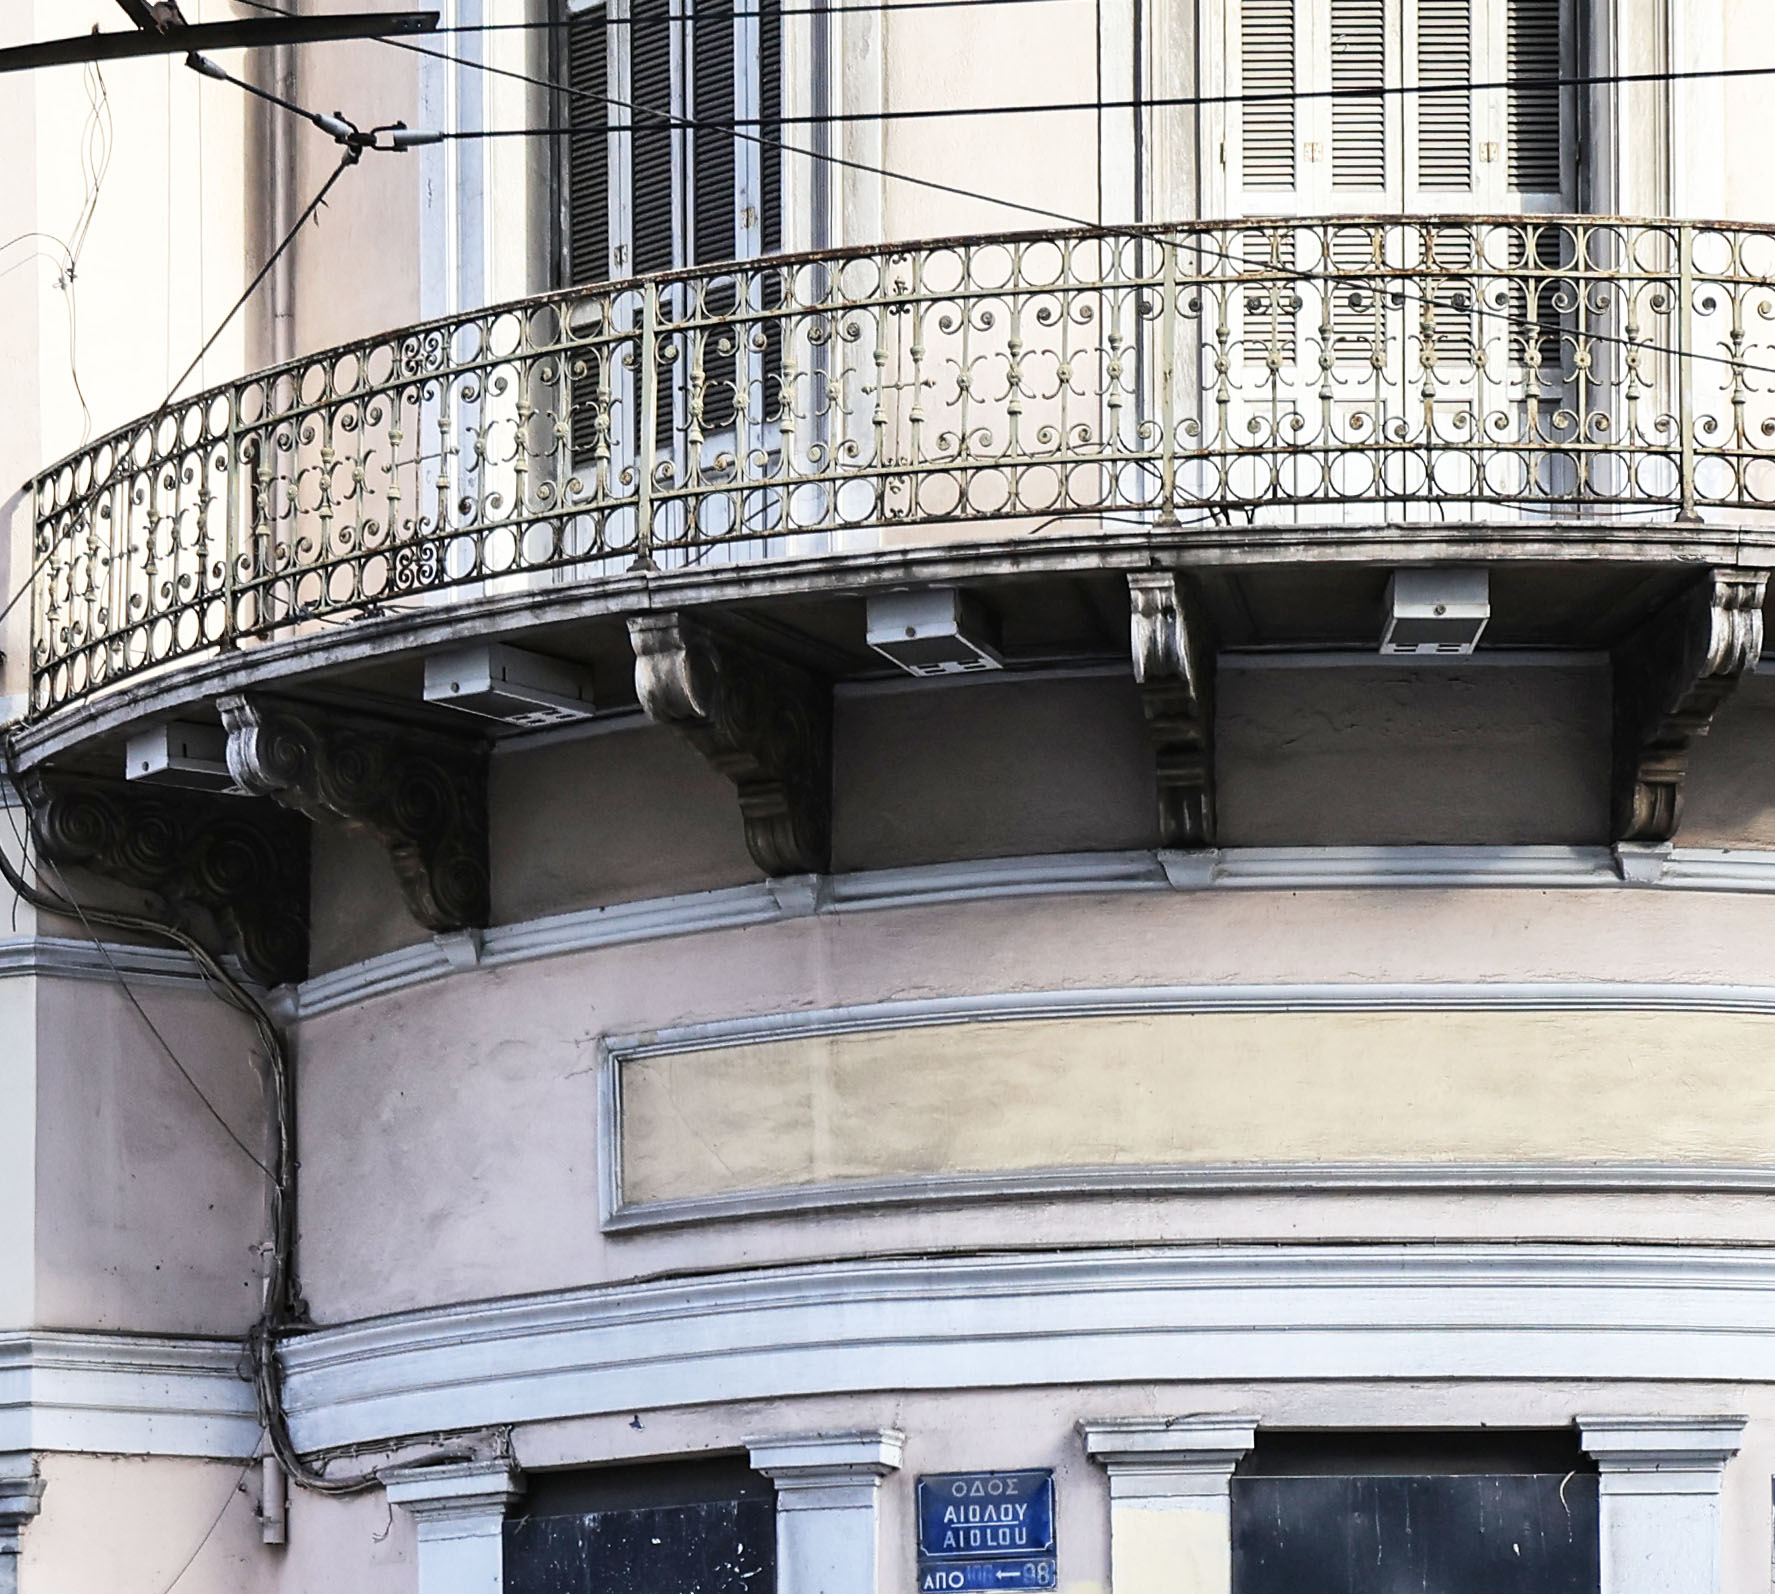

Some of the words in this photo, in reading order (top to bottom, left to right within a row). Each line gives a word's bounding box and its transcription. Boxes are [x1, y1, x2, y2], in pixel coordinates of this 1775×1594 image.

[951, 1479, 1019, 1497] ΟΔΟΣ
[943, 1503, 1028, 1523] ΑΙΟΛΟΥ
[943, 1527, 1027, 1548] AIOLOU
[923, 1571, 965, 1590] ΑΠΟ
